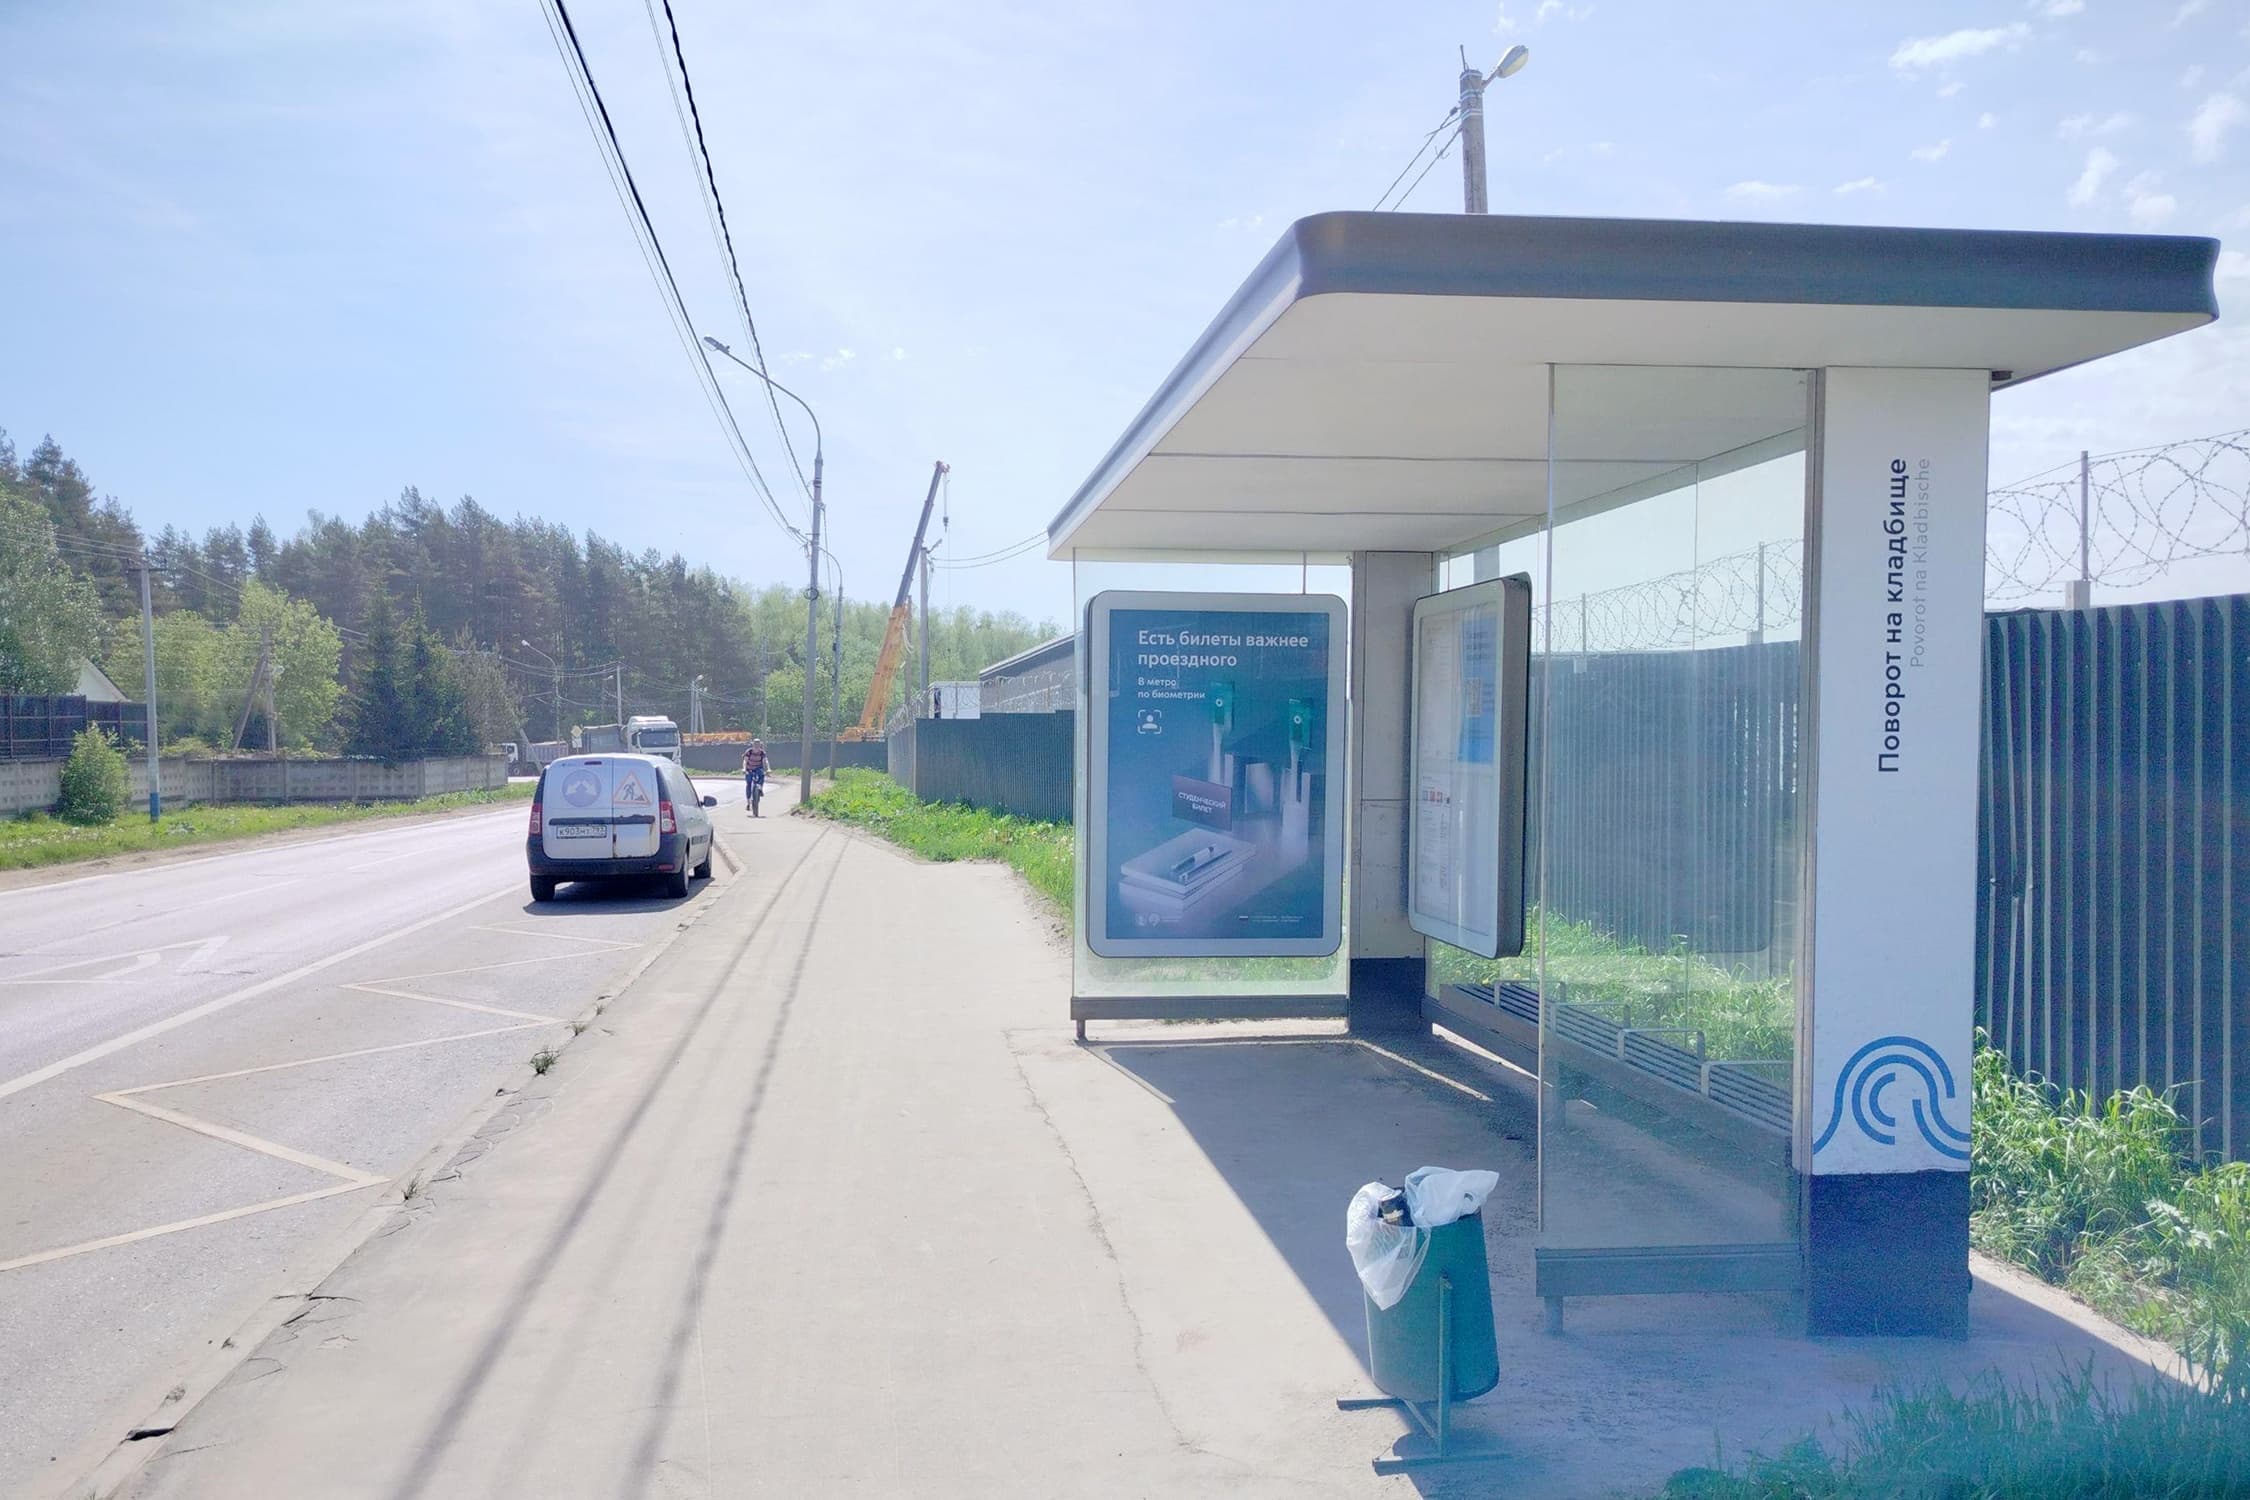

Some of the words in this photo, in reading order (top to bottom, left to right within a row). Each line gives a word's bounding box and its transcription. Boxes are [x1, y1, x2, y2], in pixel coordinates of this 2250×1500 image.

[1912, 458, 1930, 563] Kladbische
[1883, 458, 1909, 602] кладбище
[1915, 569, 1928, 591] na
[1138, 630, 1176, 646] Есть
[1179, 631, 1241, 647] билеты
[1246, 634, 1309, 647] важнее
[1886, 612, 1903, 643] на
[1910, 595, 1927, 668] Povorot
[1138, 654, 1238, 668] проездного
[1138, 677, 1145, 686] В
[1147, 678, 1177, 689] метро
[1138, 690, 1150, 699] по
[1151, 689, 1206, 700] биометрии
[1878, 651, 1905, 772] Поворот
